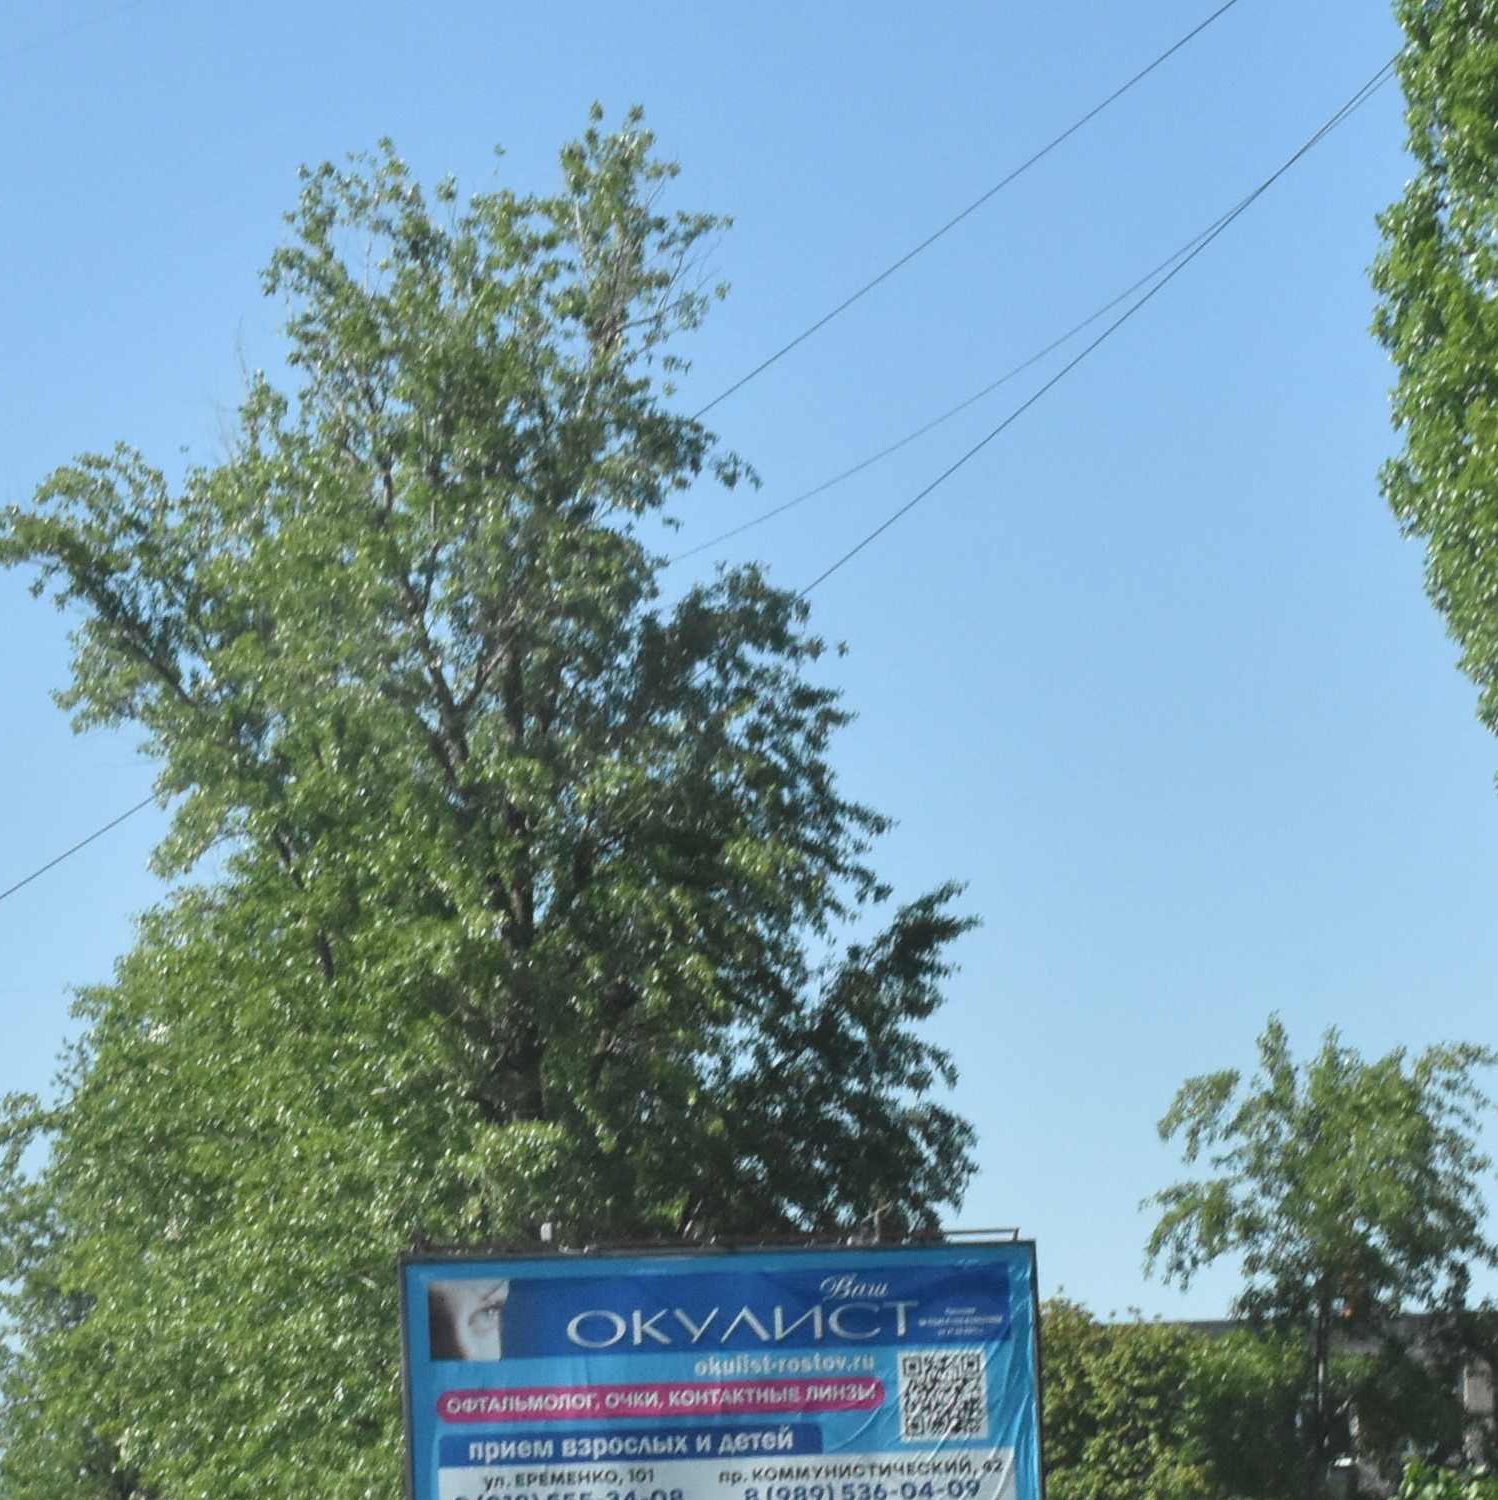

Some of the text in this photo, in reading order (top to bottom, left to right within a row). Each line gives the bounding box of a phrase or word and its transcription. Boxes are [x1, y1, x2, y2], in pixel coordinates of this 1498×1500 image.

[820, 1272, 890, 1299] Ваш
[566, 1300, 919, 1348] ОКУЛИСТ
[695, 1352, 876, 1377] okulist-rostov.ru
[446, 1381, 877, 1415] ОФТАЛЬМОЛОГ, ОЧКИ, КОНТАКТНЫЕ ЛИНЗЫ
[468, 1425, 794, 1463] прием взрослых и детей
[483, 1475, 510, 1492] ул.
[628, 1467, 655, 1484] 101
[718, 1470, 747, 1487] пр.
[752, 1455, 978, 1482] КОММУНИСТИЧЕСКИЙ,
